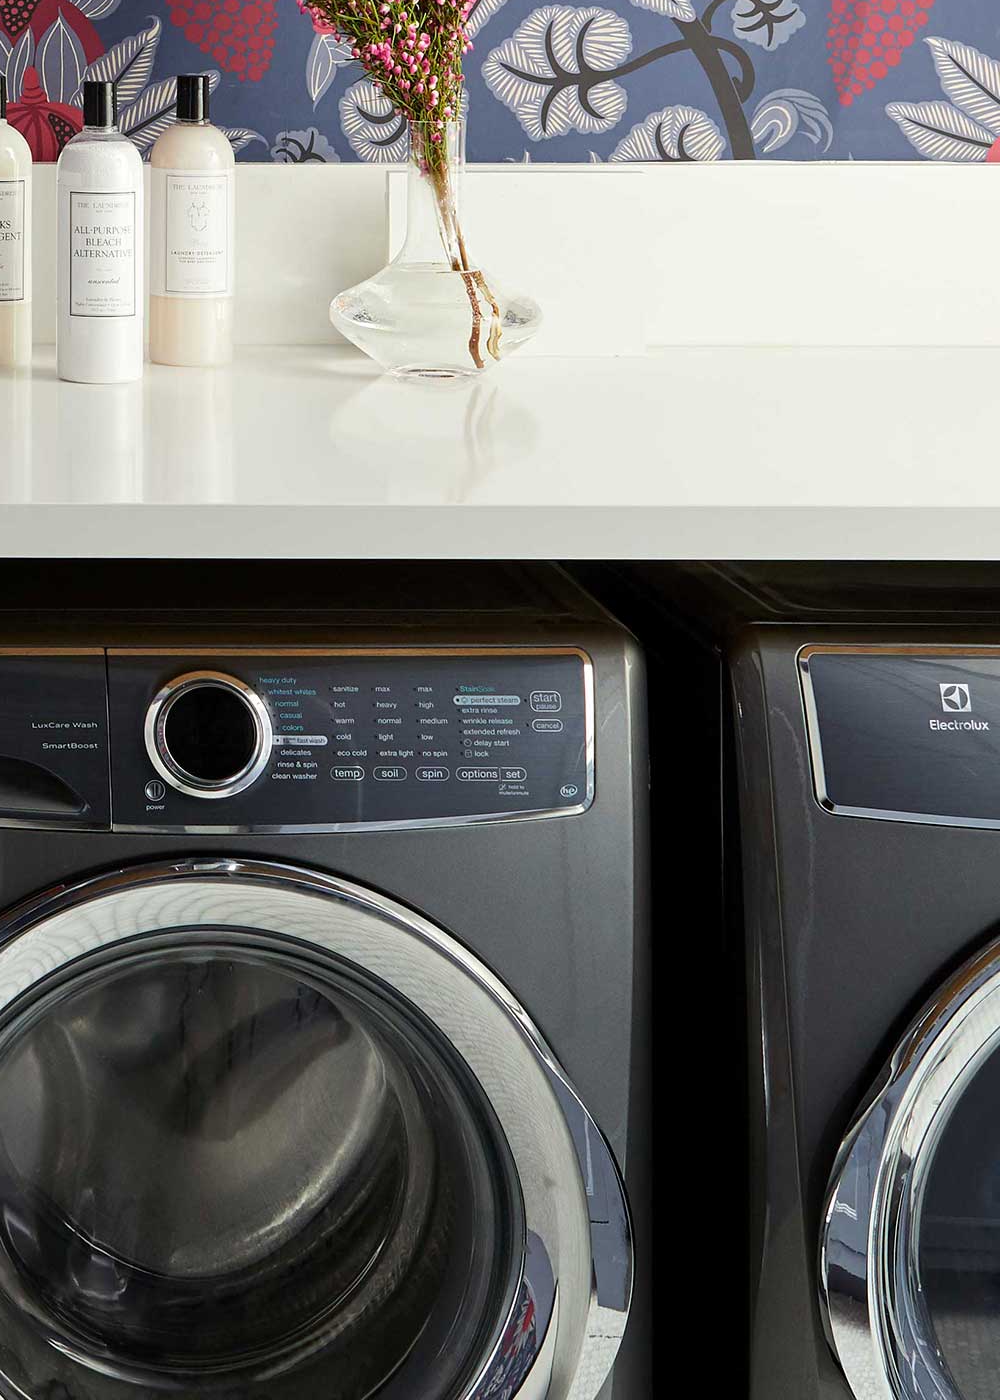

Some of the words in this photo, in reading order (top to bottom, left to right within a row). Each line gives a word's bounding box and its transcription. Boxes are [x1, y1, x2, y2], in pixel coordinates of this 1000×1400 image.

[86, 238, 122, 246] BLEACH
[74, 249, 132, 258] ALTERNATIVE
[534, 693, 558, 702] start
[929, 719, 990, 730] Electrolux
[378, 734, 394, 742] light
[398, 750, 414, 758] light
[433, 750, 448, 758] spin
[334, 769, 360, 779] temp
[382, 768, 398, 778] soil
[422, 769, 443, 780] spin
[462, 770, 498, 779] options
[506, 770, 520, 778] set
